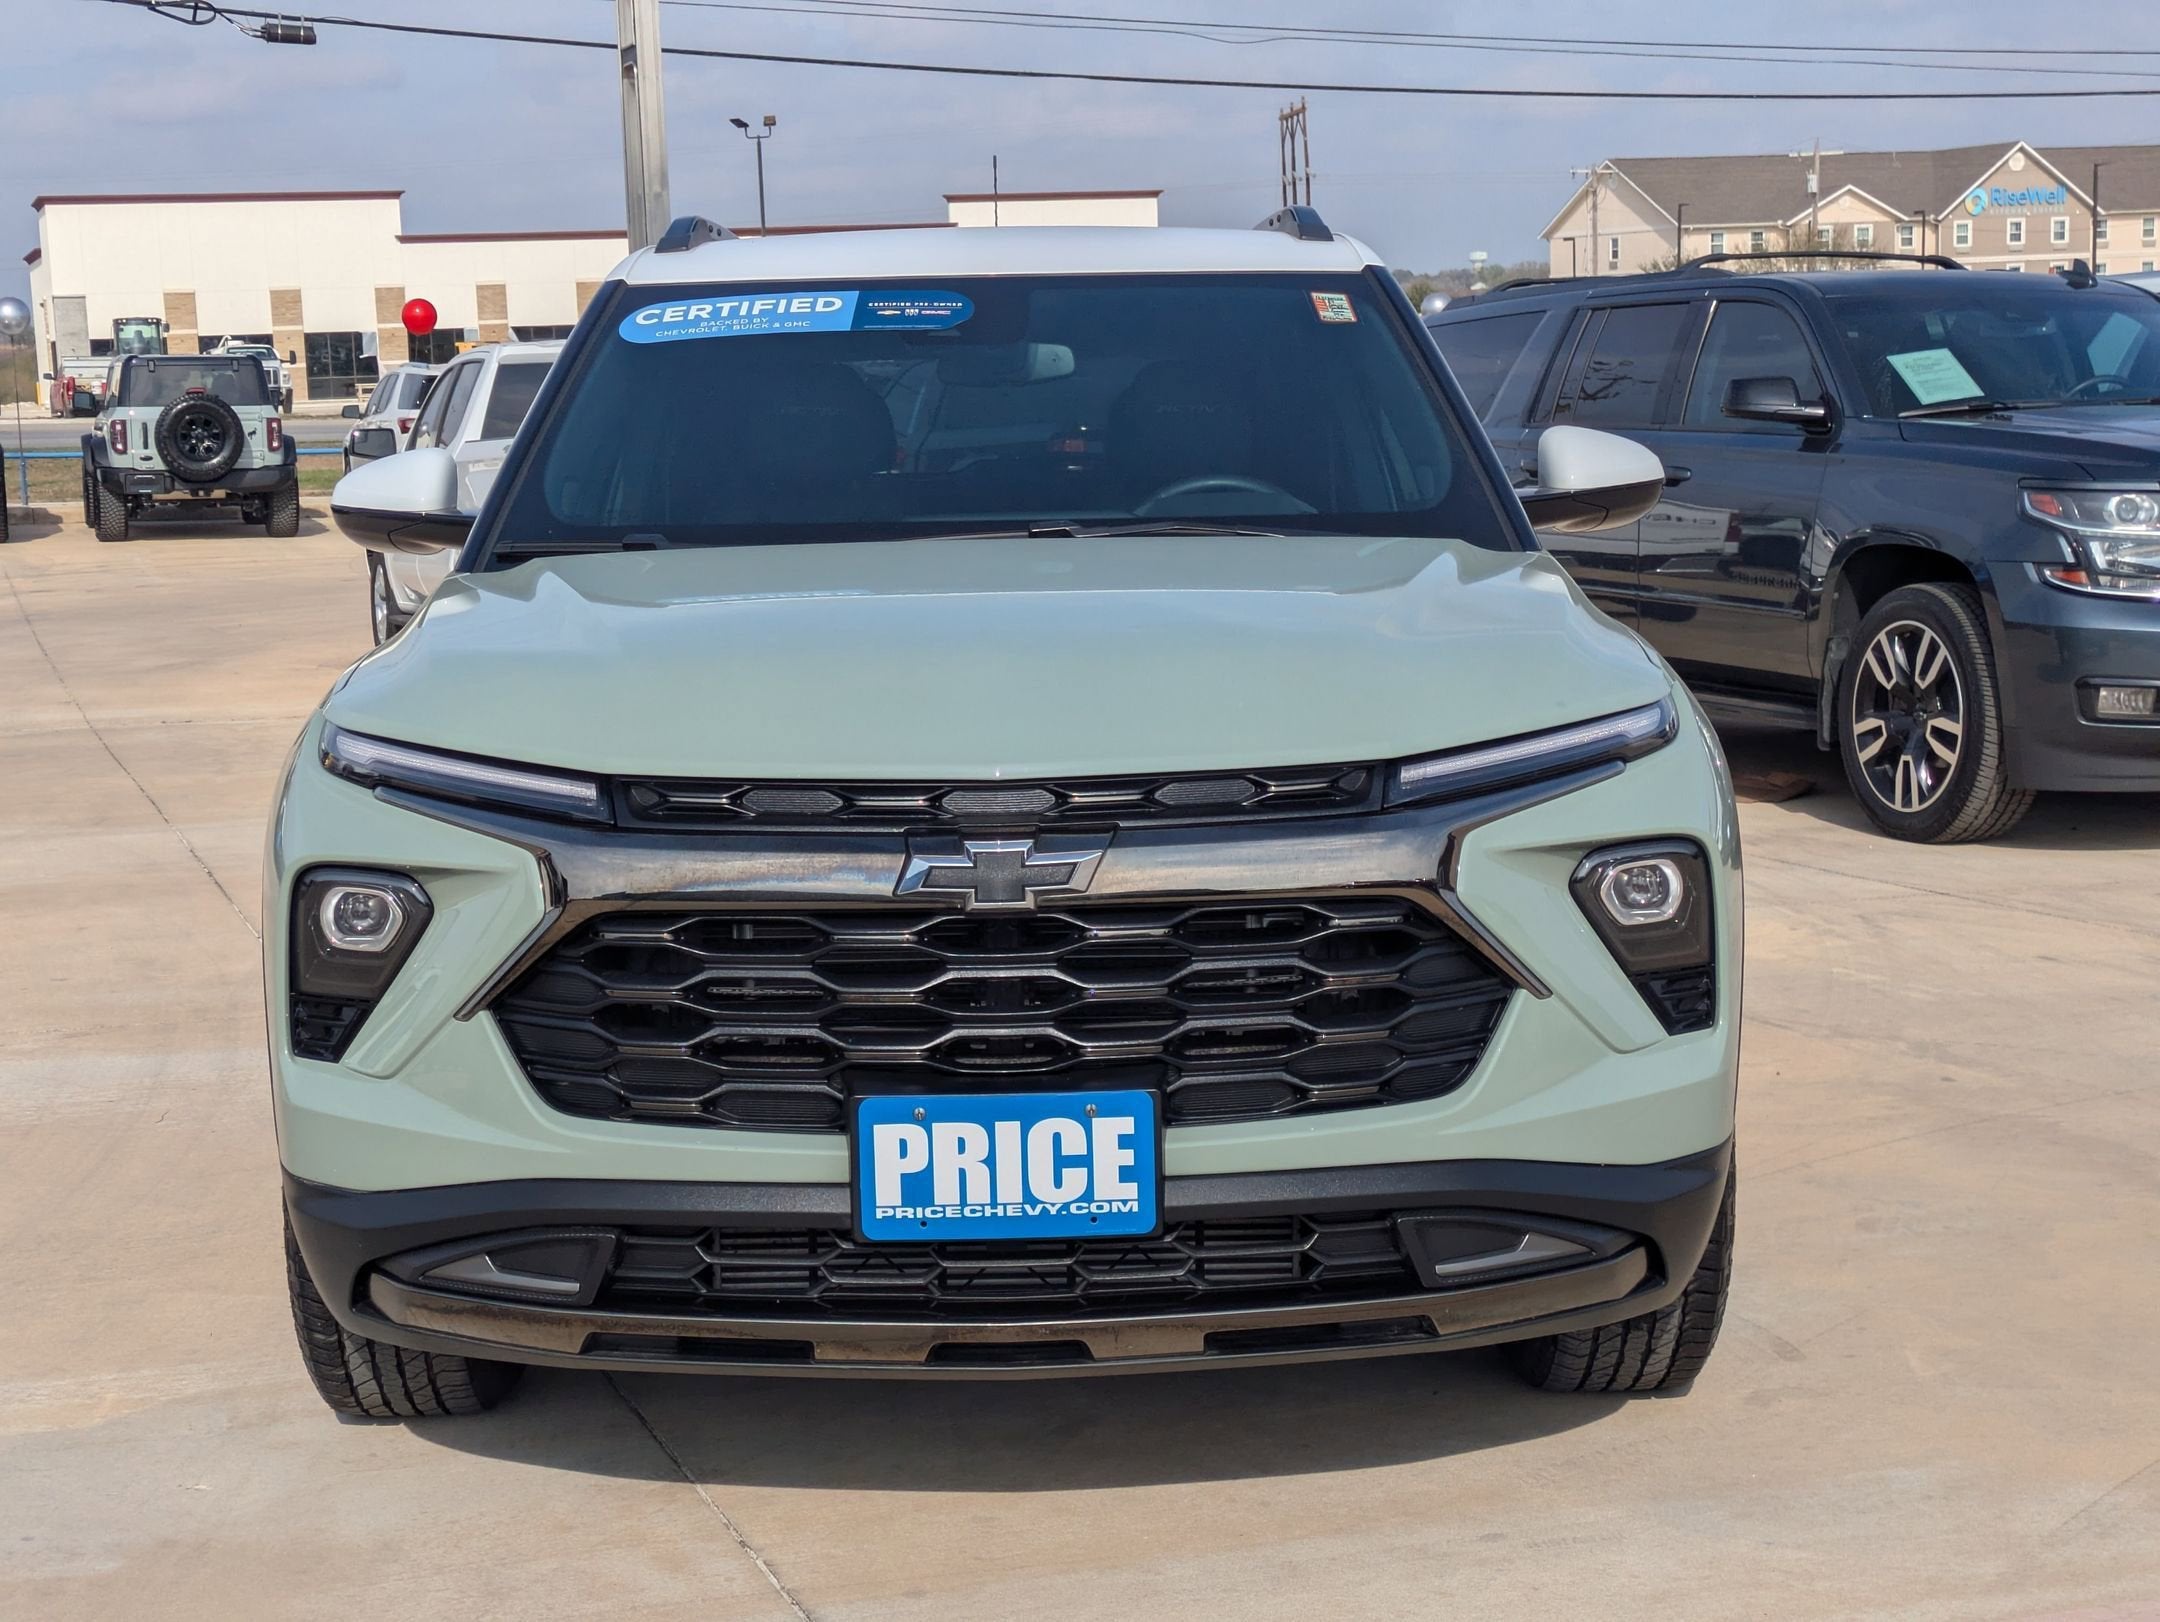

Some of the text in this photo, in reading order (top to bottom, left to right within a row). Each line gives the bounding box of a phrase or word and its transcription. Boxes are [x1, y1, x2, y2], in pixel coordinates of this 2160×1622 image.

[1990, 185, 2066, 207] RiseWell
[635, 296, 843, 325] CERTIFIED
[700, 318, 748, 327] BACKED
[873, 1116, 1138, 1206] PRICE
[875, 1201, 1139, 1219] PRICECHEVY.COM
